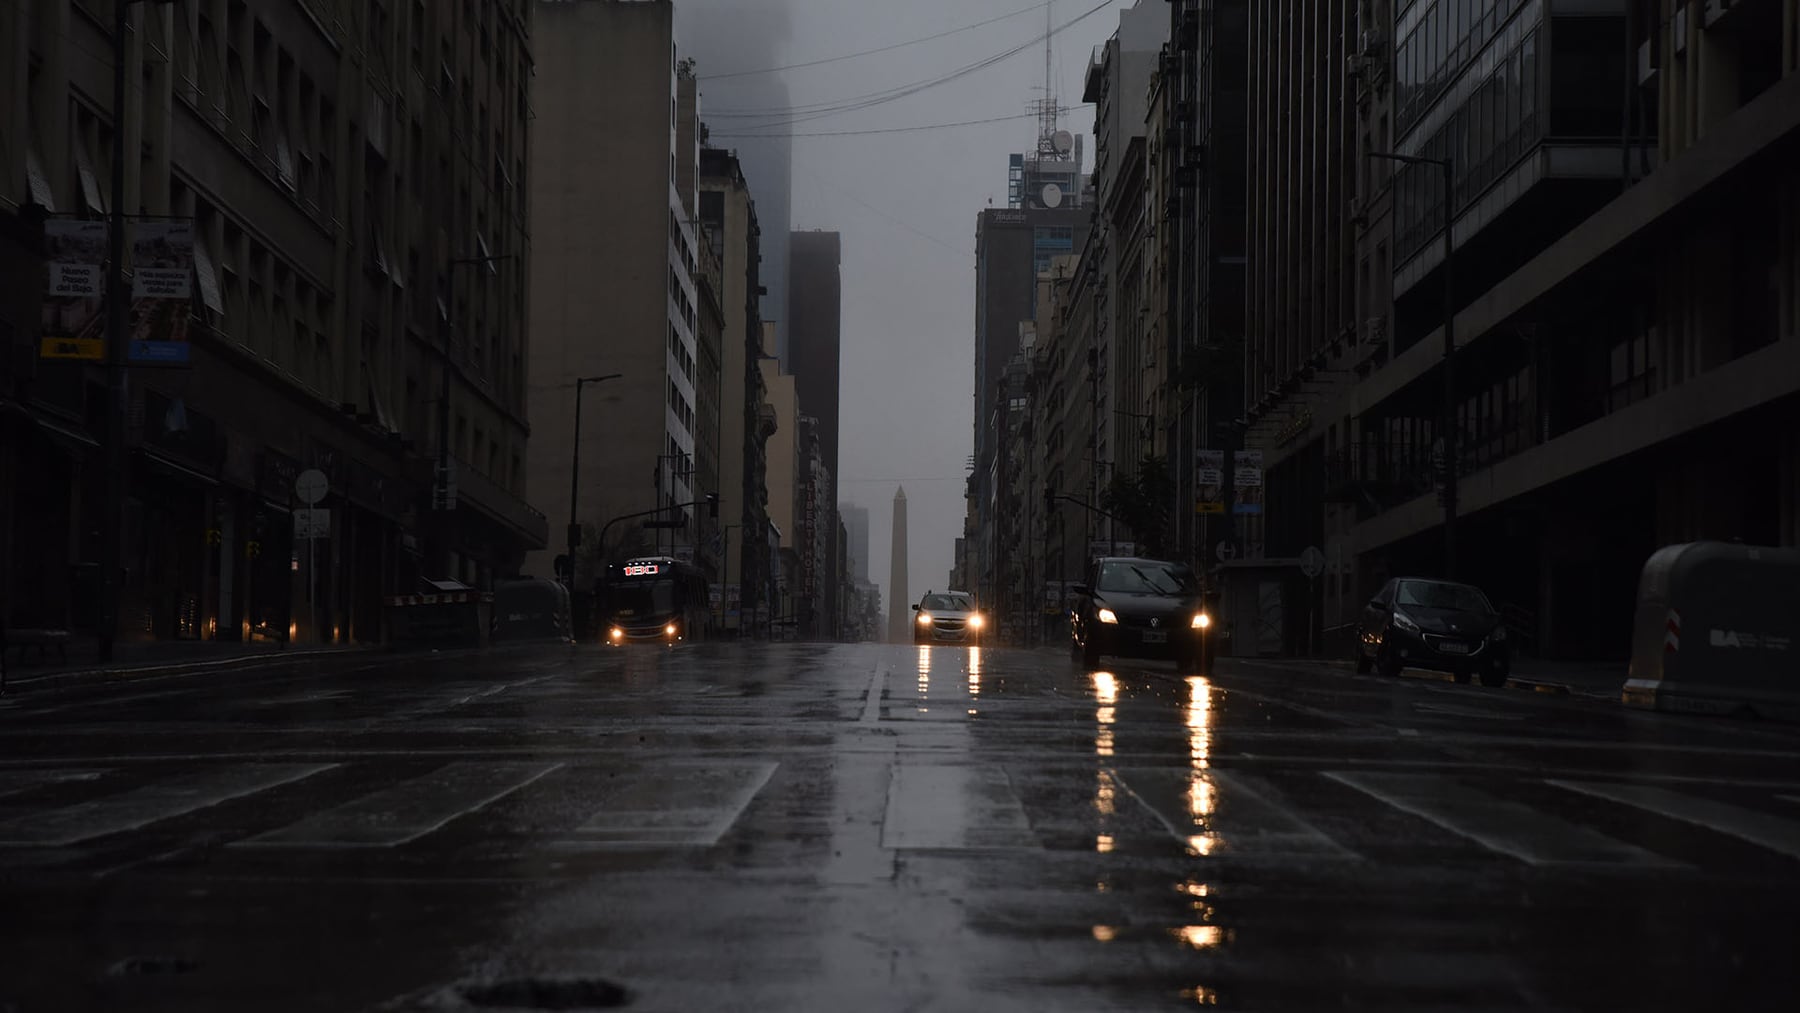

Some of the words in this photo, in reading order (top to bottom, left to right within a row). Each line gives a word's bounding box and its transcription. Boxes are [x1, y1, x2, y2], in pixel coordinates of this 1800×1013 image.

[61, 266, 90, 276] Nuevo
[62, 276, 89, 284] Paseo
[805, 481, 815, 549] LIBERTY
[623, 565, 659, 576] 180
[804, 551, 814, 596] HOTEL
